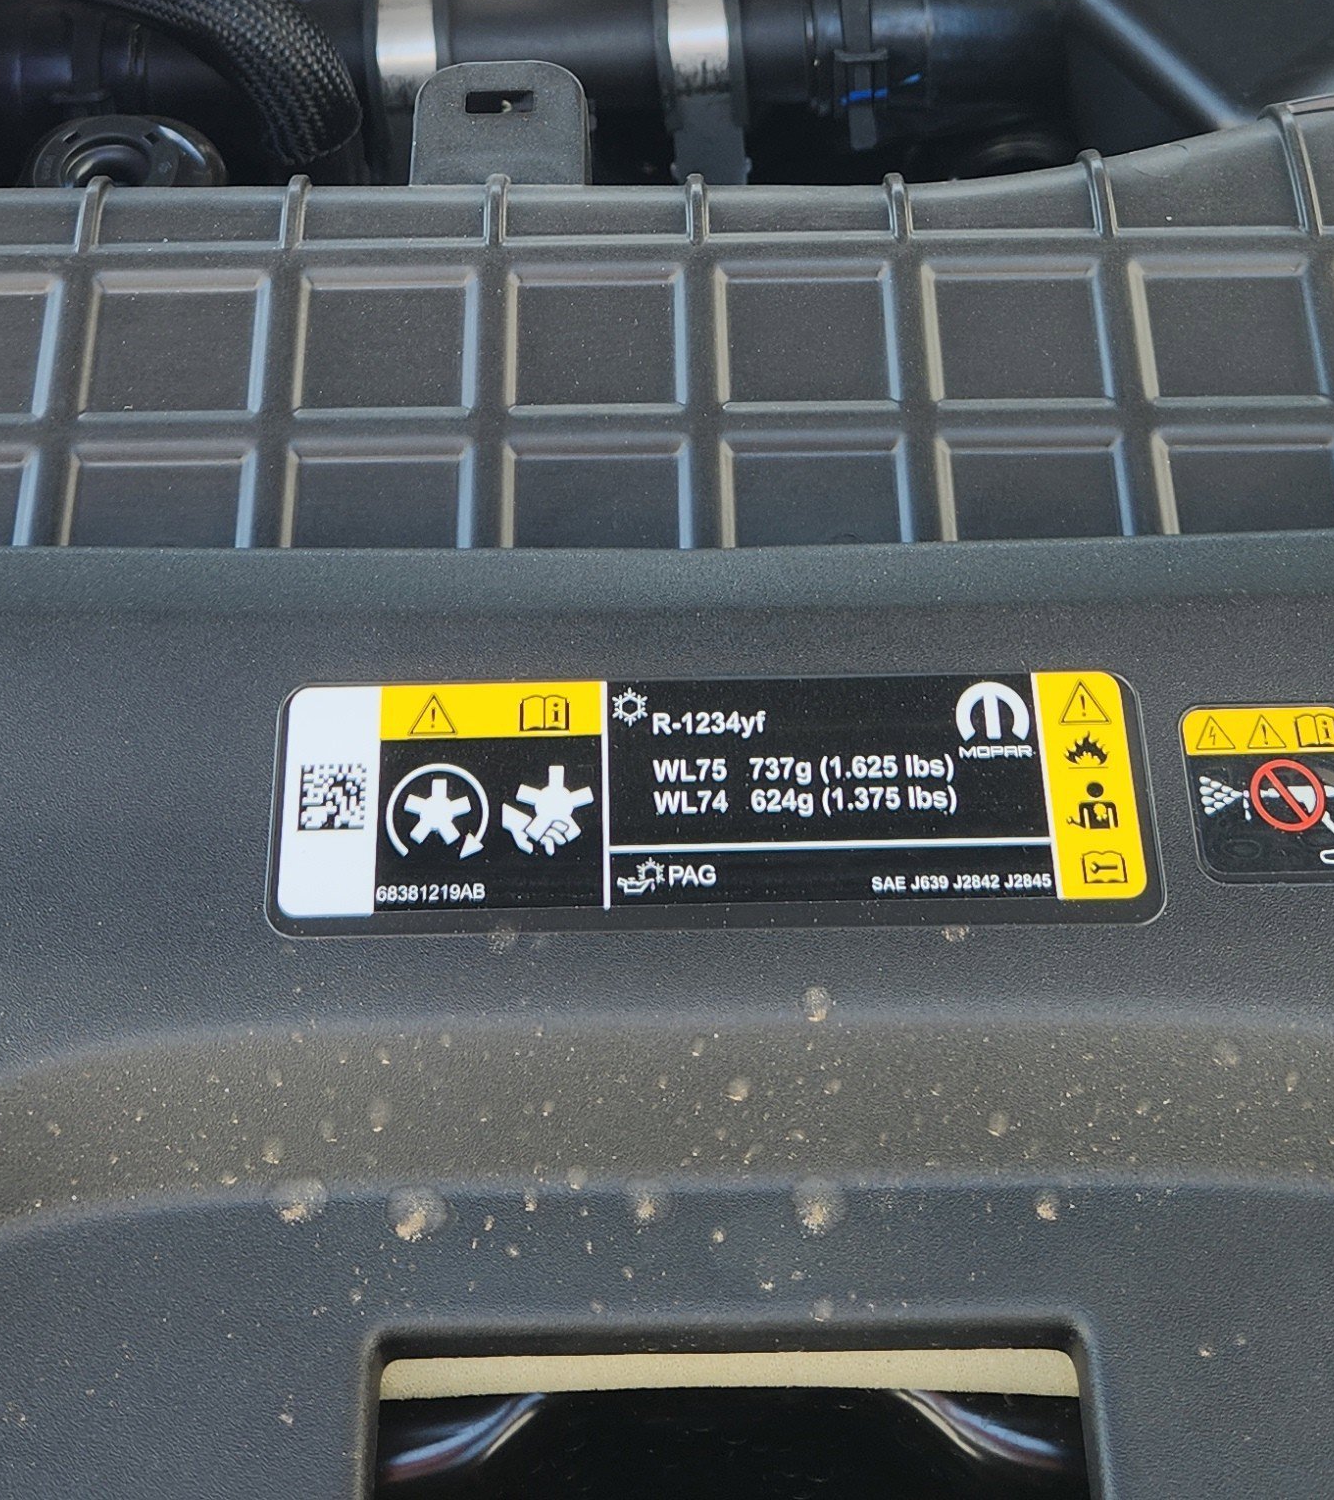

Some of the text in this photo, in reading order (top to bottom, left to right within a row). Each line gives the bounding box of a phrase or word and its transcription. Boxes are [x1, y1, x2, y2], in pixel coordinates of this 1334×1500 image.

[652, 710, 766, 739] R-1234yf
[958, 744, 1033, 759] MOPAR
[653, 754, 954, 785] WL75 737g (1.625 lbs)
[653, 785, 958, 817] WL74 624g (1.375 lbs)
[668, 864, 717, 888] PAG
[871, 873, 1052, 892] SAE J639 J2842 J2845
[375, 883, 486, 903] 68381219AB
